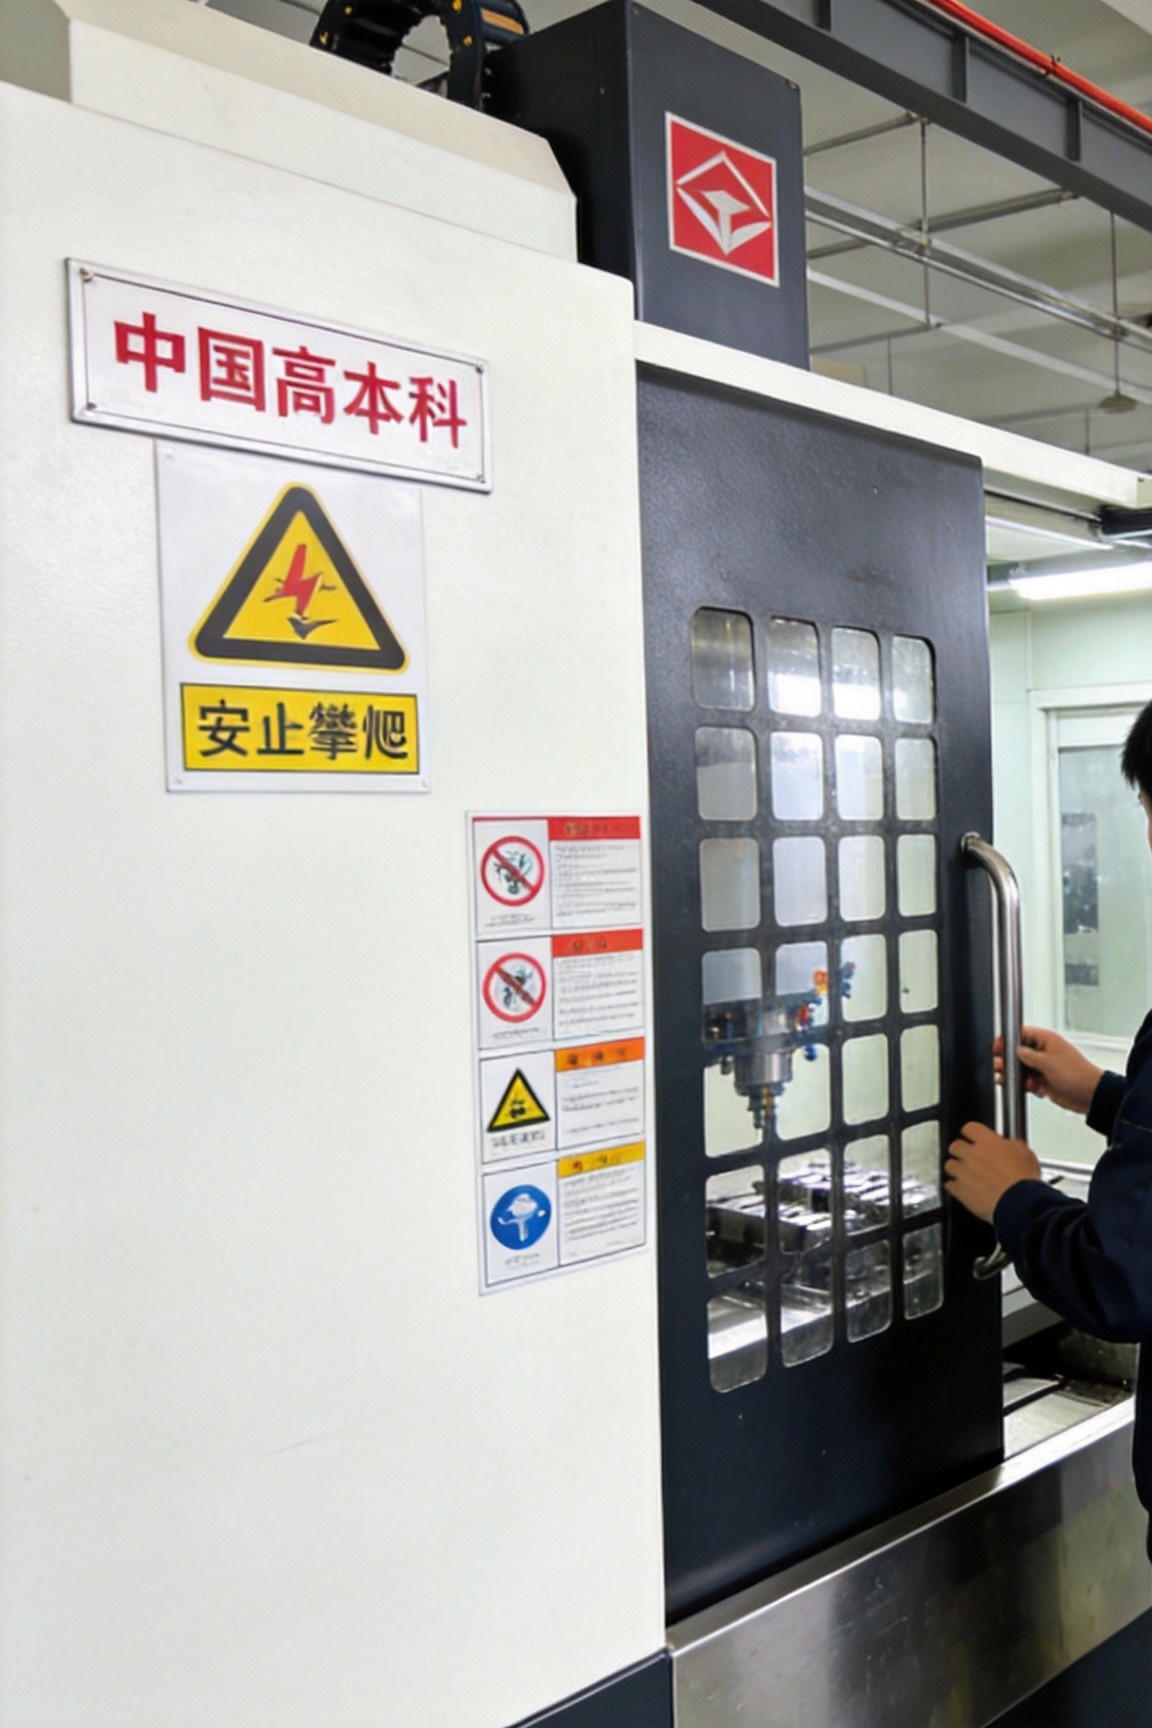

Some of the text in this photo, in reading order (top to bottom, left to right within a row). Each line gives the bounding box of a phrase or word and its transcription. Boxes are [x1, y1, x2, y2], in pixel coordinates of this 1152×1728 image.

[114, 311, 468, 449] 中国高本科
